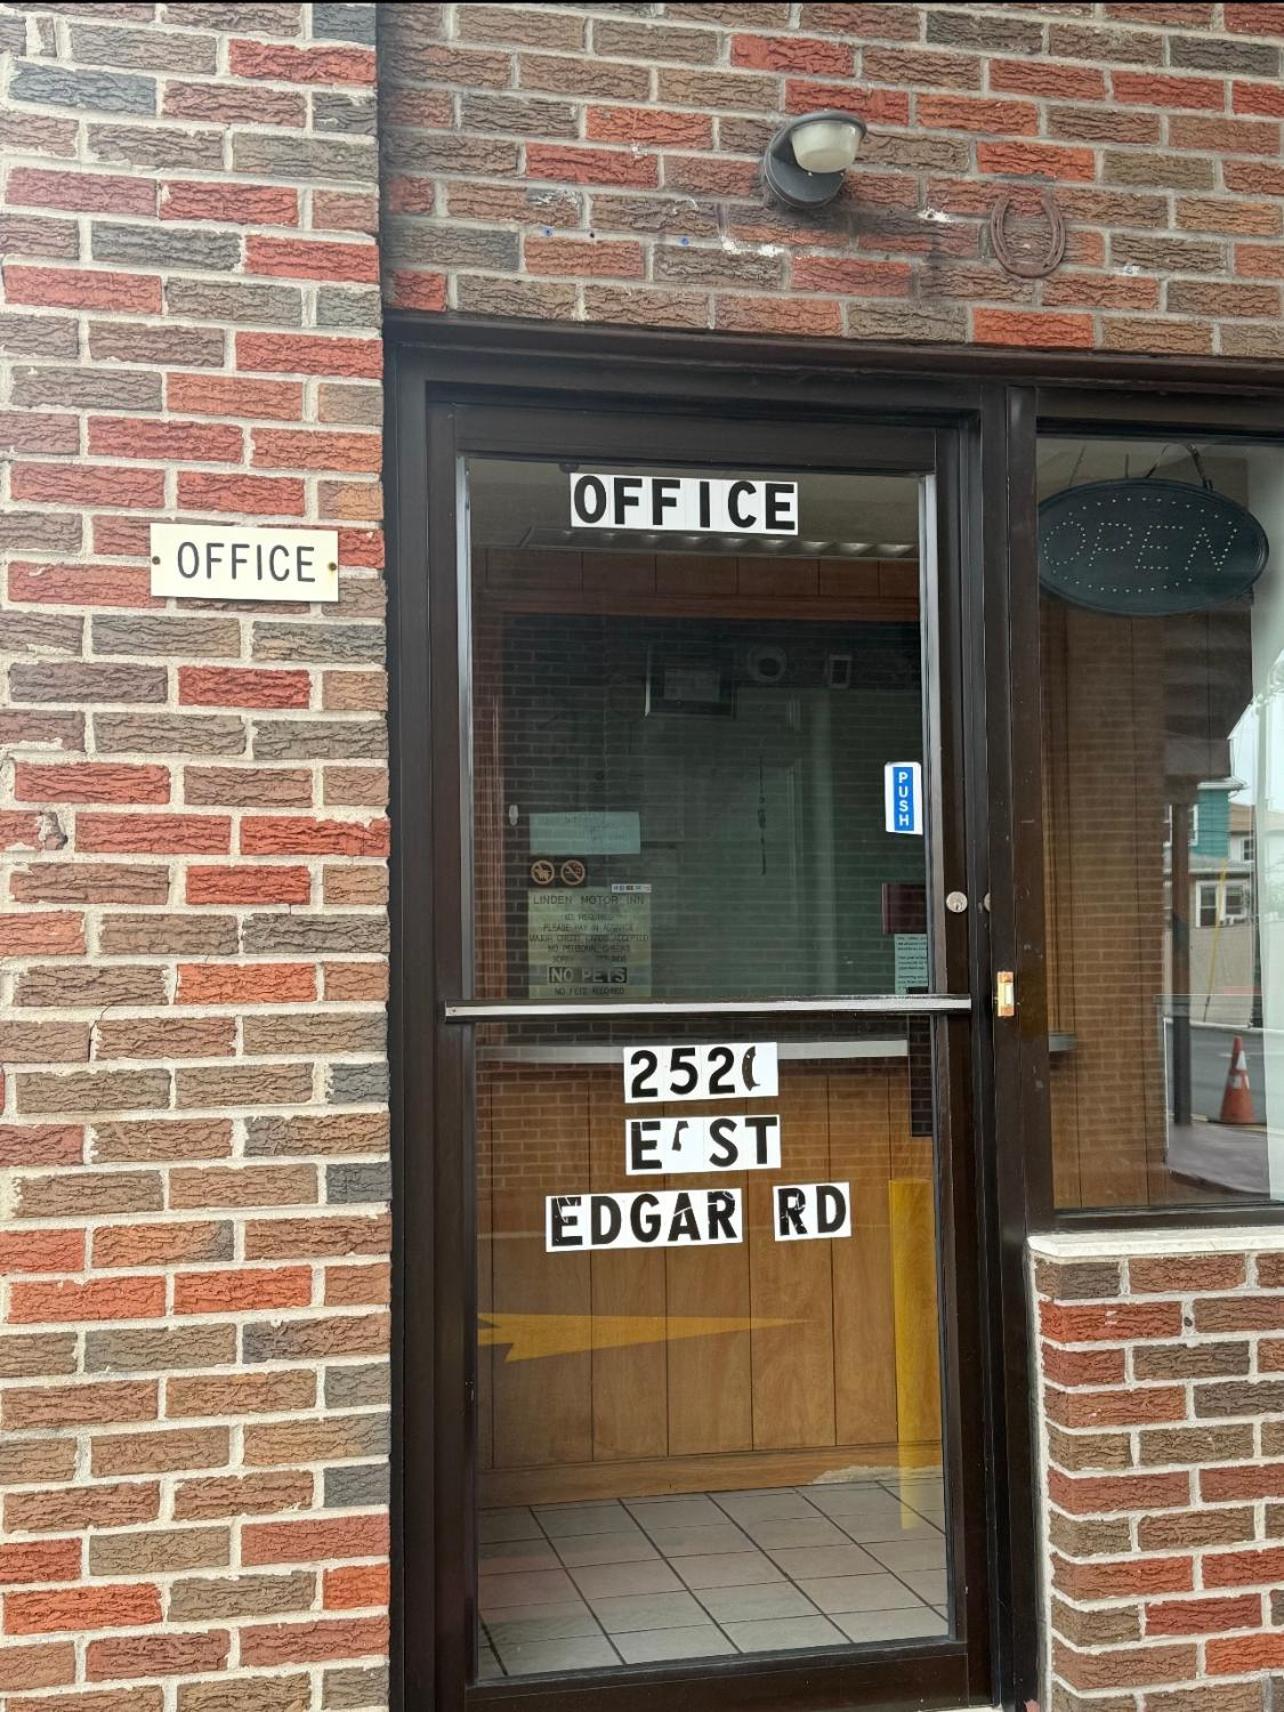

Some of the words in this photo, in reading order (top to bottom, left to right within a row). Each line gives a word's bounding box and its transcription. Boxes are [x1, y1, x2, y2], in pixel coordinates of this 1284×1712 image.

[573, 474, 796, 531] OFFICE
[177, 541, 316, 583] OFFICE
[1043, 519, 1238, 573] OPEN
[898, 771, 909, 826] PUSH
[533, 895, 572, 905] LINDEN
[580, 895, 618, 905] MOTOR
[628, 895, 645, 905] INN
[551, 967, 573, 982] NO
[581, 967, 626, 983] PETS
[630, 1116, 778, 1171] EST
[550, 1190, 738, 1247] EDGAR
[778, 1184, 847, 1236] RD
